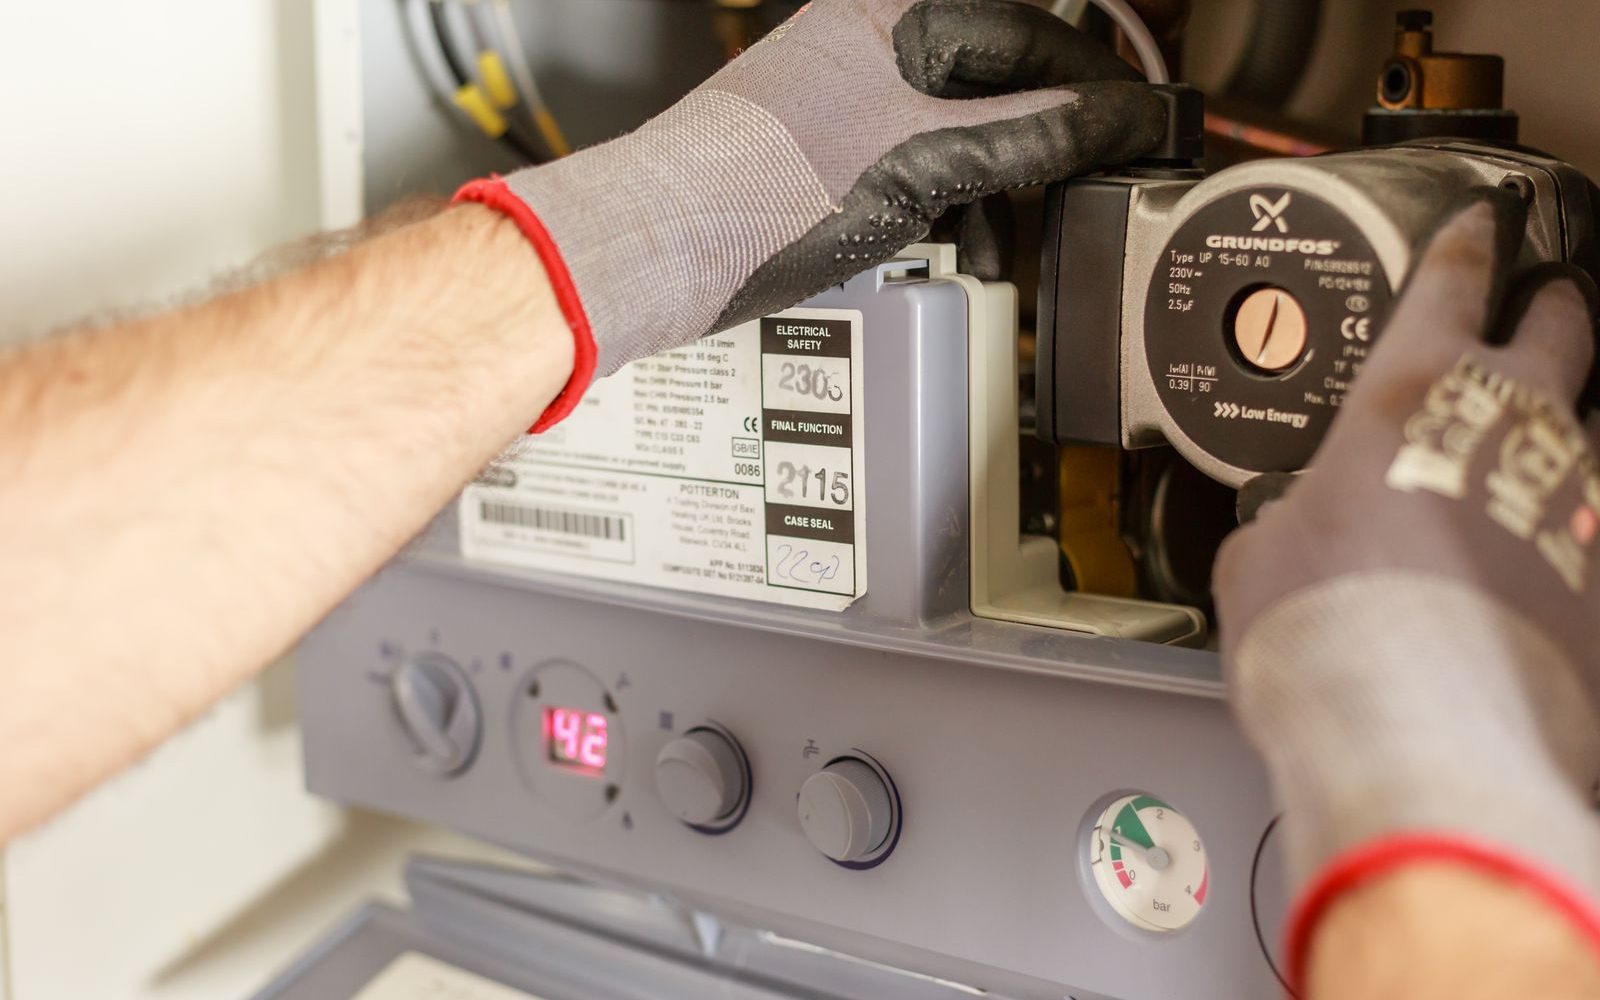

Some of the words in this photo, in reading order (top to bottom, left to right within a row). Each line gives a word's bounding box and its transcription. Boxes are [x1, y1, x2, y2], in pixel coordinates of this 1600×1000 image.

[1206, 235, 1335, 255] GRUNDFOS
[1170, 250, 1194, 264] Type
[1200, 252, 1212, 263] UP
[1218, 253, 1249, 266] 15-60
[1168, 283, 1191, 295] 50Hz
[776, 325, 831, 337] ELECTRICAL
[787, 339, 821, 350] SAFETY
[675, 365, 707, 375] Pressure
[710, 367, 729, 377] class
[731, 368, 736, 377] 2
[669, 378, 701, 389] Pressure
[710, 381, 723, 390] bar
[1169, 379, 1189, 390] 0.39
[1199, 381, 1210, 392] 90
[669, 391, 702, 402] Pressure
[717, 396, 730, 404] bar
[1241, 405, 1265, 420] Low
[1266, 408, 1310, 428] Energy
[771, 420, 796, 431] FINAL
[798, 422, 843, 435] FUNCTION
[735, 463, 760, 477] 0086
[680, 484, 739, 499] POTTERTON
[784, 515, 809, 527] CASE
[810, 518, 834, 530] SEAL
[553, 708, 607, 767] 42
[1156, 809, 1164, 819] 2
[1193, 841, 1200, 852] 3
[1129, 870, 1136, 880] 0
[1185, 885, 1192, 895] 4
[1153, 899, 1171, 912] bar
